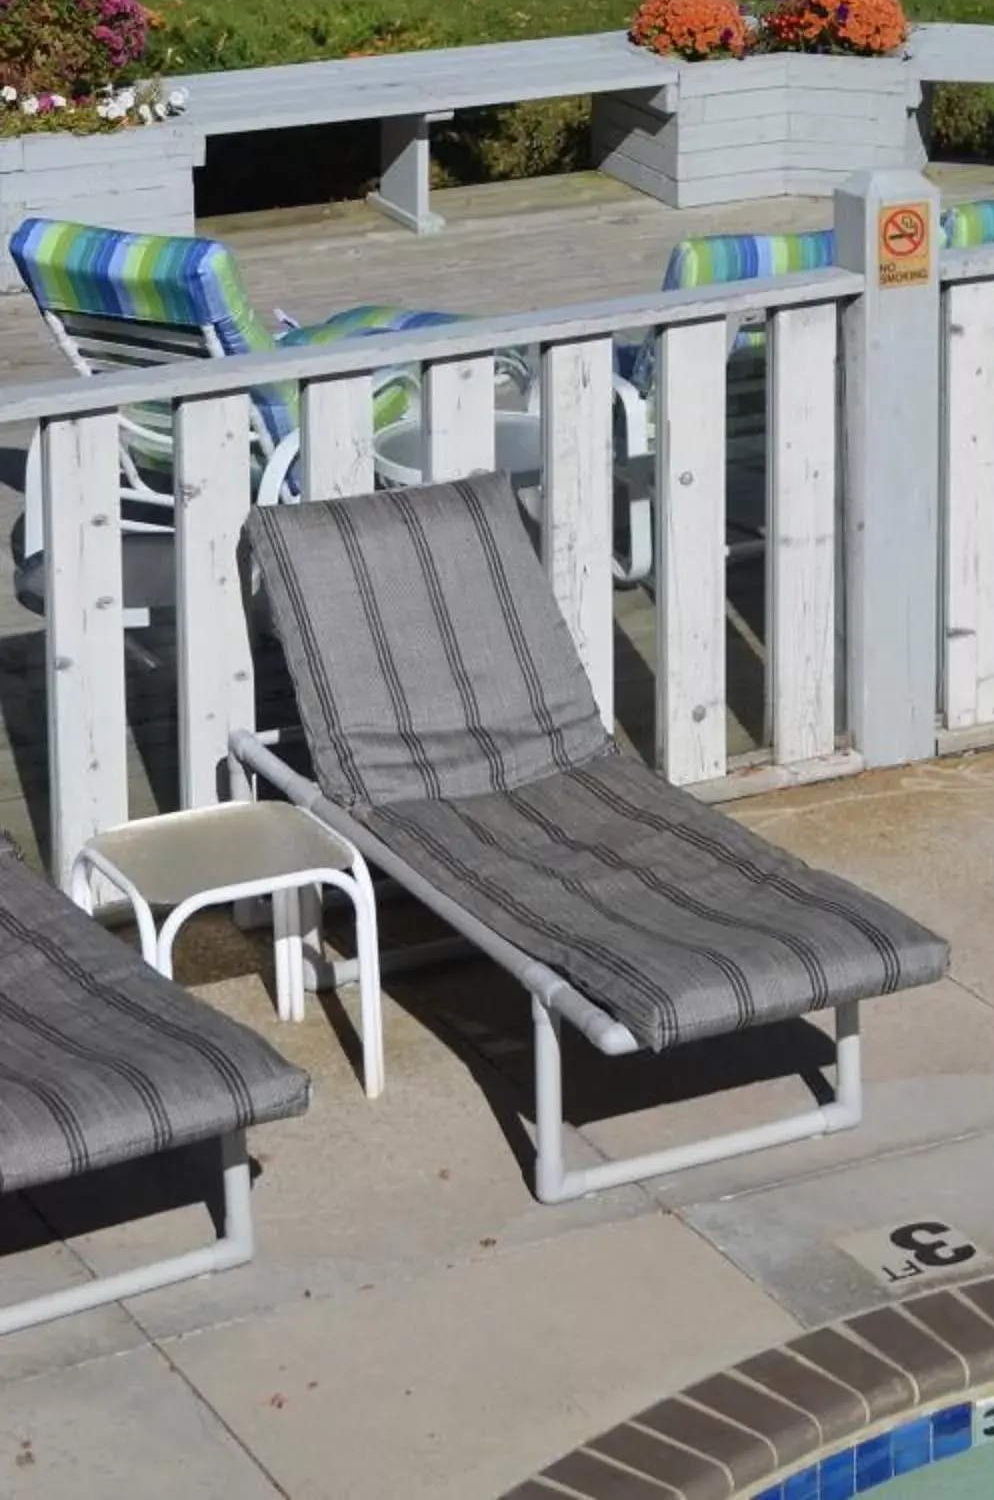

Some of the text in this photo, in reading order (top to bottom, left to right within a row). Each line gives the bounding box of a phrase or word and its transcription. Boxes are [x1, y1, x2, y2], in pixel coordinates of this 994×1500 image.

[879, 263, 896, 274] NO
[881, 1221, 977, 1283] 3 FT
